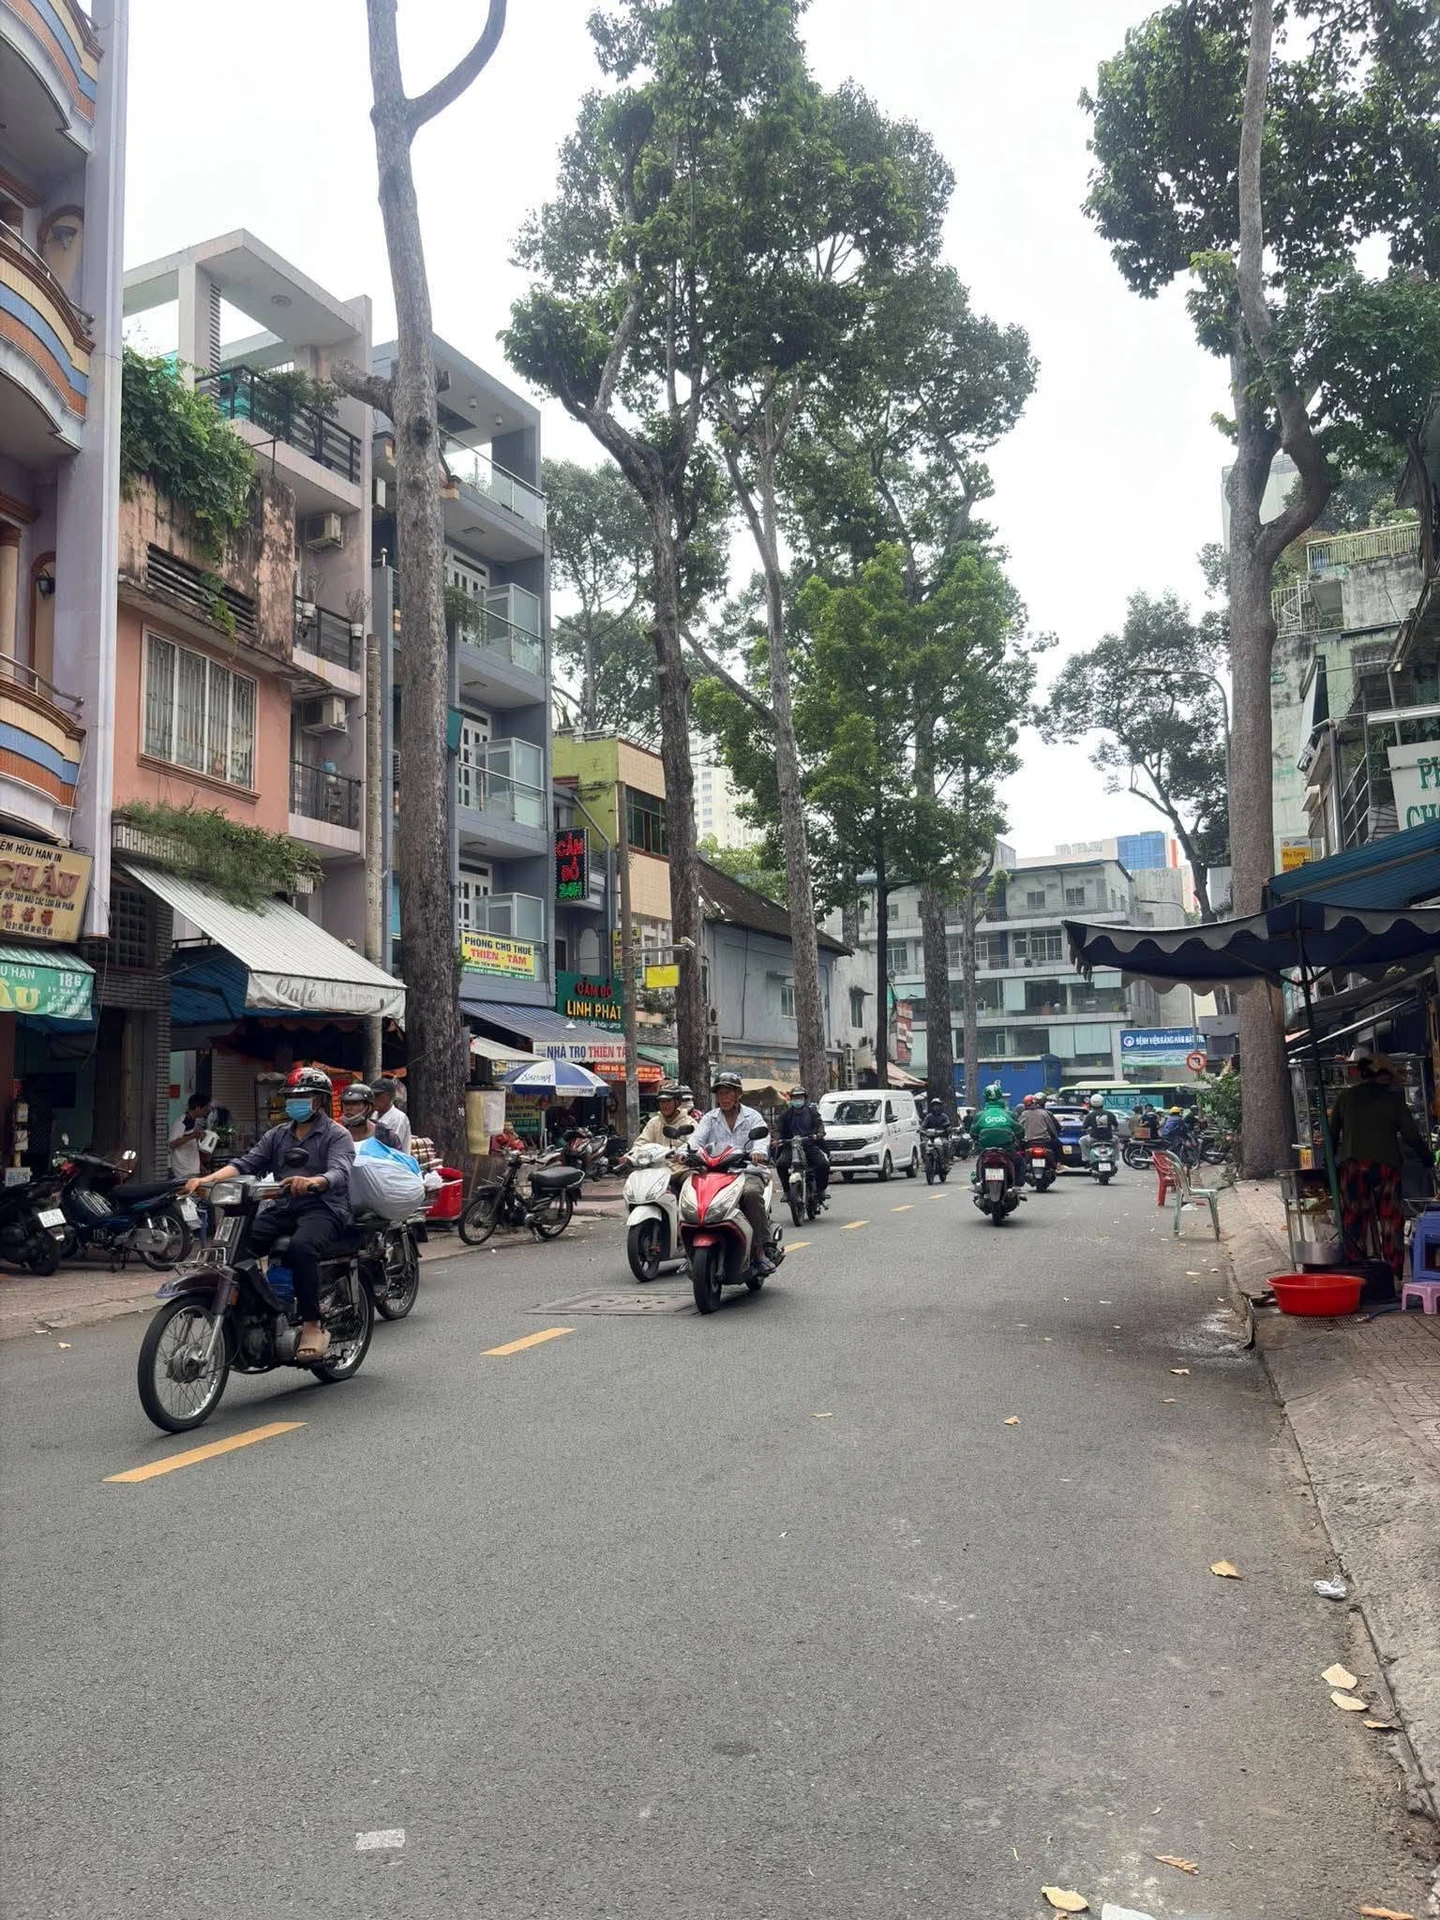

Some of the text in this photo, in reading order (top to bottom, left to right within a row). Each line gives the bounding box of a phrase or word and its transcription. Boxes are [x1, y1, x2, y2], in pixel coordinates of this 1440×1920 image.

[54, 854, 63, 862] IN
[495, 942, 511, 952] CHO
[11, 967, 35, 980] HẠN
[567, 1000, 622, 1020] LINH PHÁT
[546, 1043, 566, 1059] NHÀ
[985, 1115, 1007, 1124] Grab
